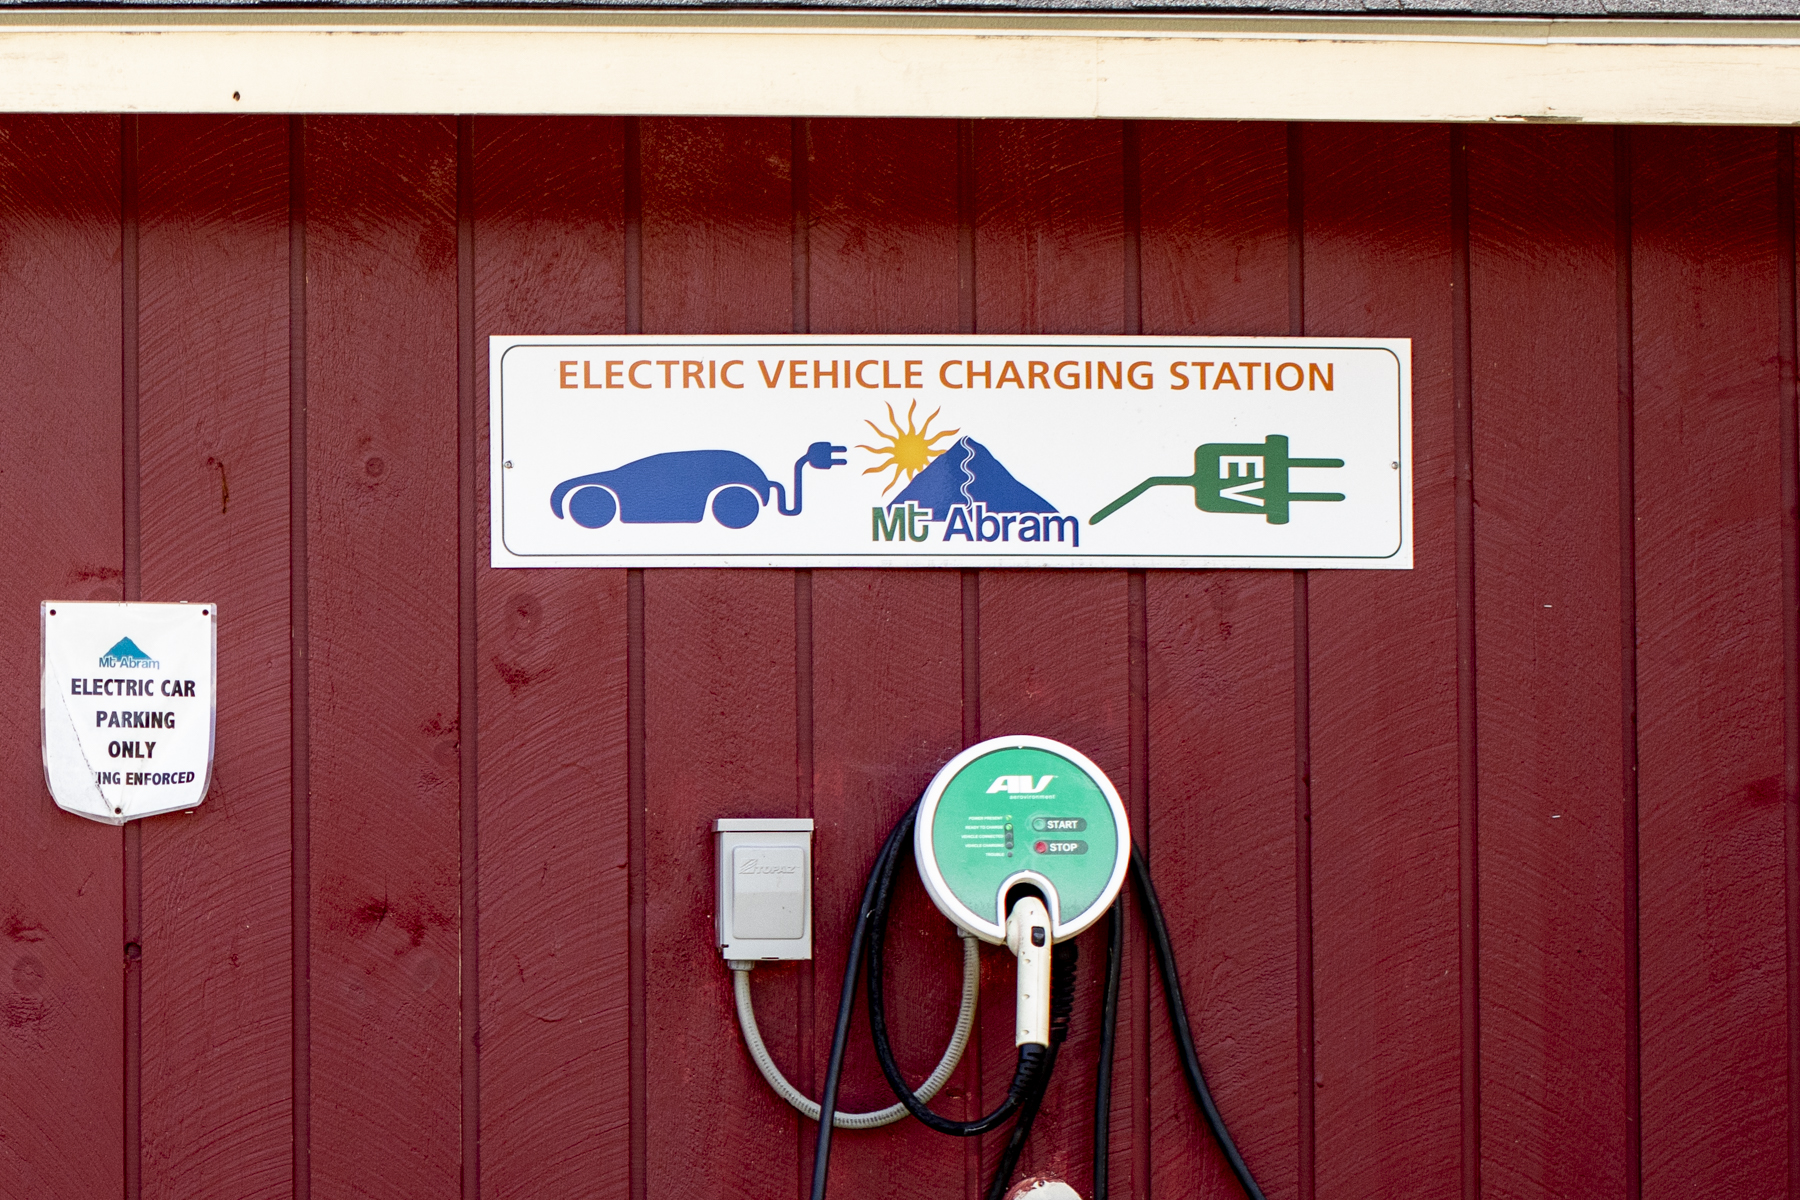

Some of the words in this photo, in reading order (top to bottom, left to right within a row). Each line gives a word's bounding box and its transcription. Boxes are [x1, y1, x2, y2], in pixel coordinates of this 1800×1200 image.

[559, 359, 744, 391] ELECTRIC
[757, 359, 923, 390] VEHICLE
[938, 359, 1153, 391] CHARGING
[1169, 361, 1335, 392] STATION
[1219, 455, 1265, 507] EV
[872, 503, 929, 542] Mt
[942, 504, 1079, 547] Abram
[98, 657, 116, 668] Mt
[119, 656, 160, 670] Abram
[71, 678, 154, 696] ELECTRIC
[160, 679, 196, 697] CAR
[96, 710, 175, 729] PARKING
[108, 740, 156, 758] ONLY
[95, 771, 121, 785] ING
[125, 771, 195, 786] ENFORCED
[1047, 820, 1078, 829] START
[1049, 843, 1078, 852] STOP
